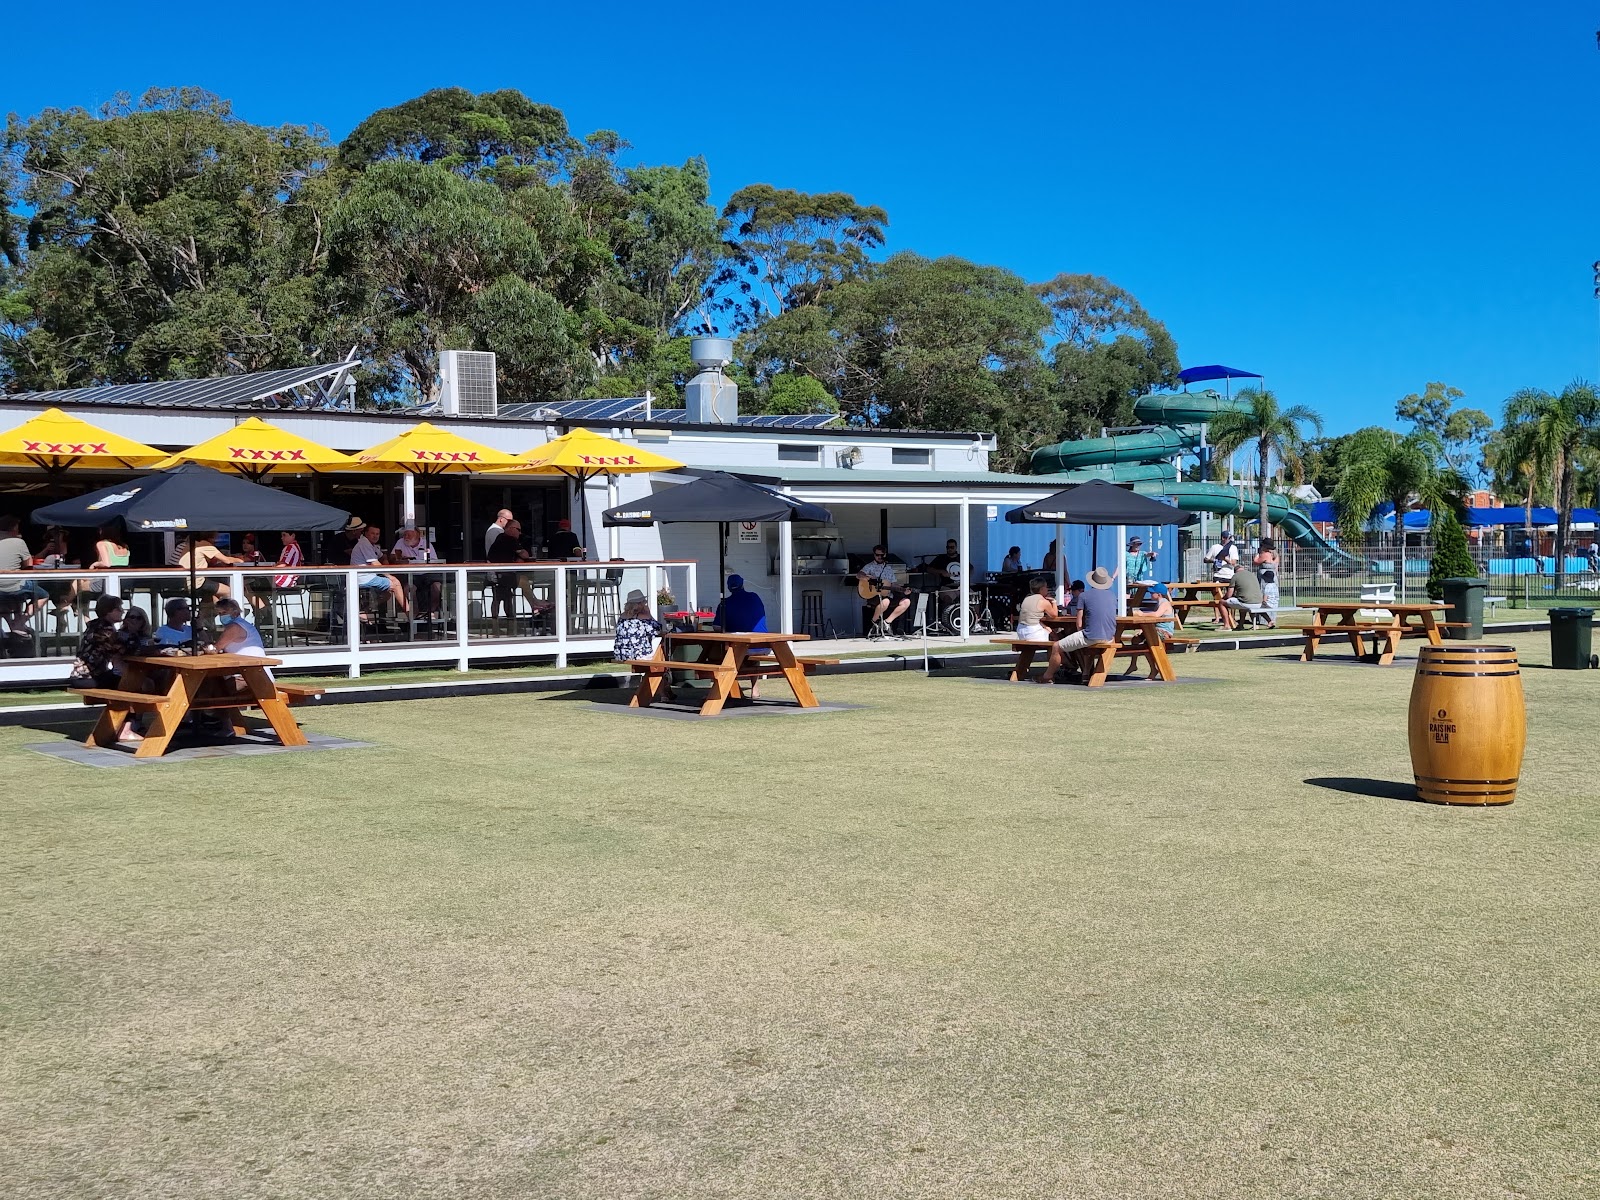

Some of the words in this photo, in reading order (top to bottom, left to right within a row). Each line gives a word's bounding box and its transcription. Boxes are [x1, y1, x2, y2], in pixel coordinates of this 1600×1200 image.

[22, 440, 110, 454] XXXX
[228, 447, 307, 460] XXXX
[411, 450, 483, 461] XXXX
[577, 454, 641, 465] XXXX
[1429, 723, 1456, 733] RAISING
[1435, 732, 1449, 742] BAR
